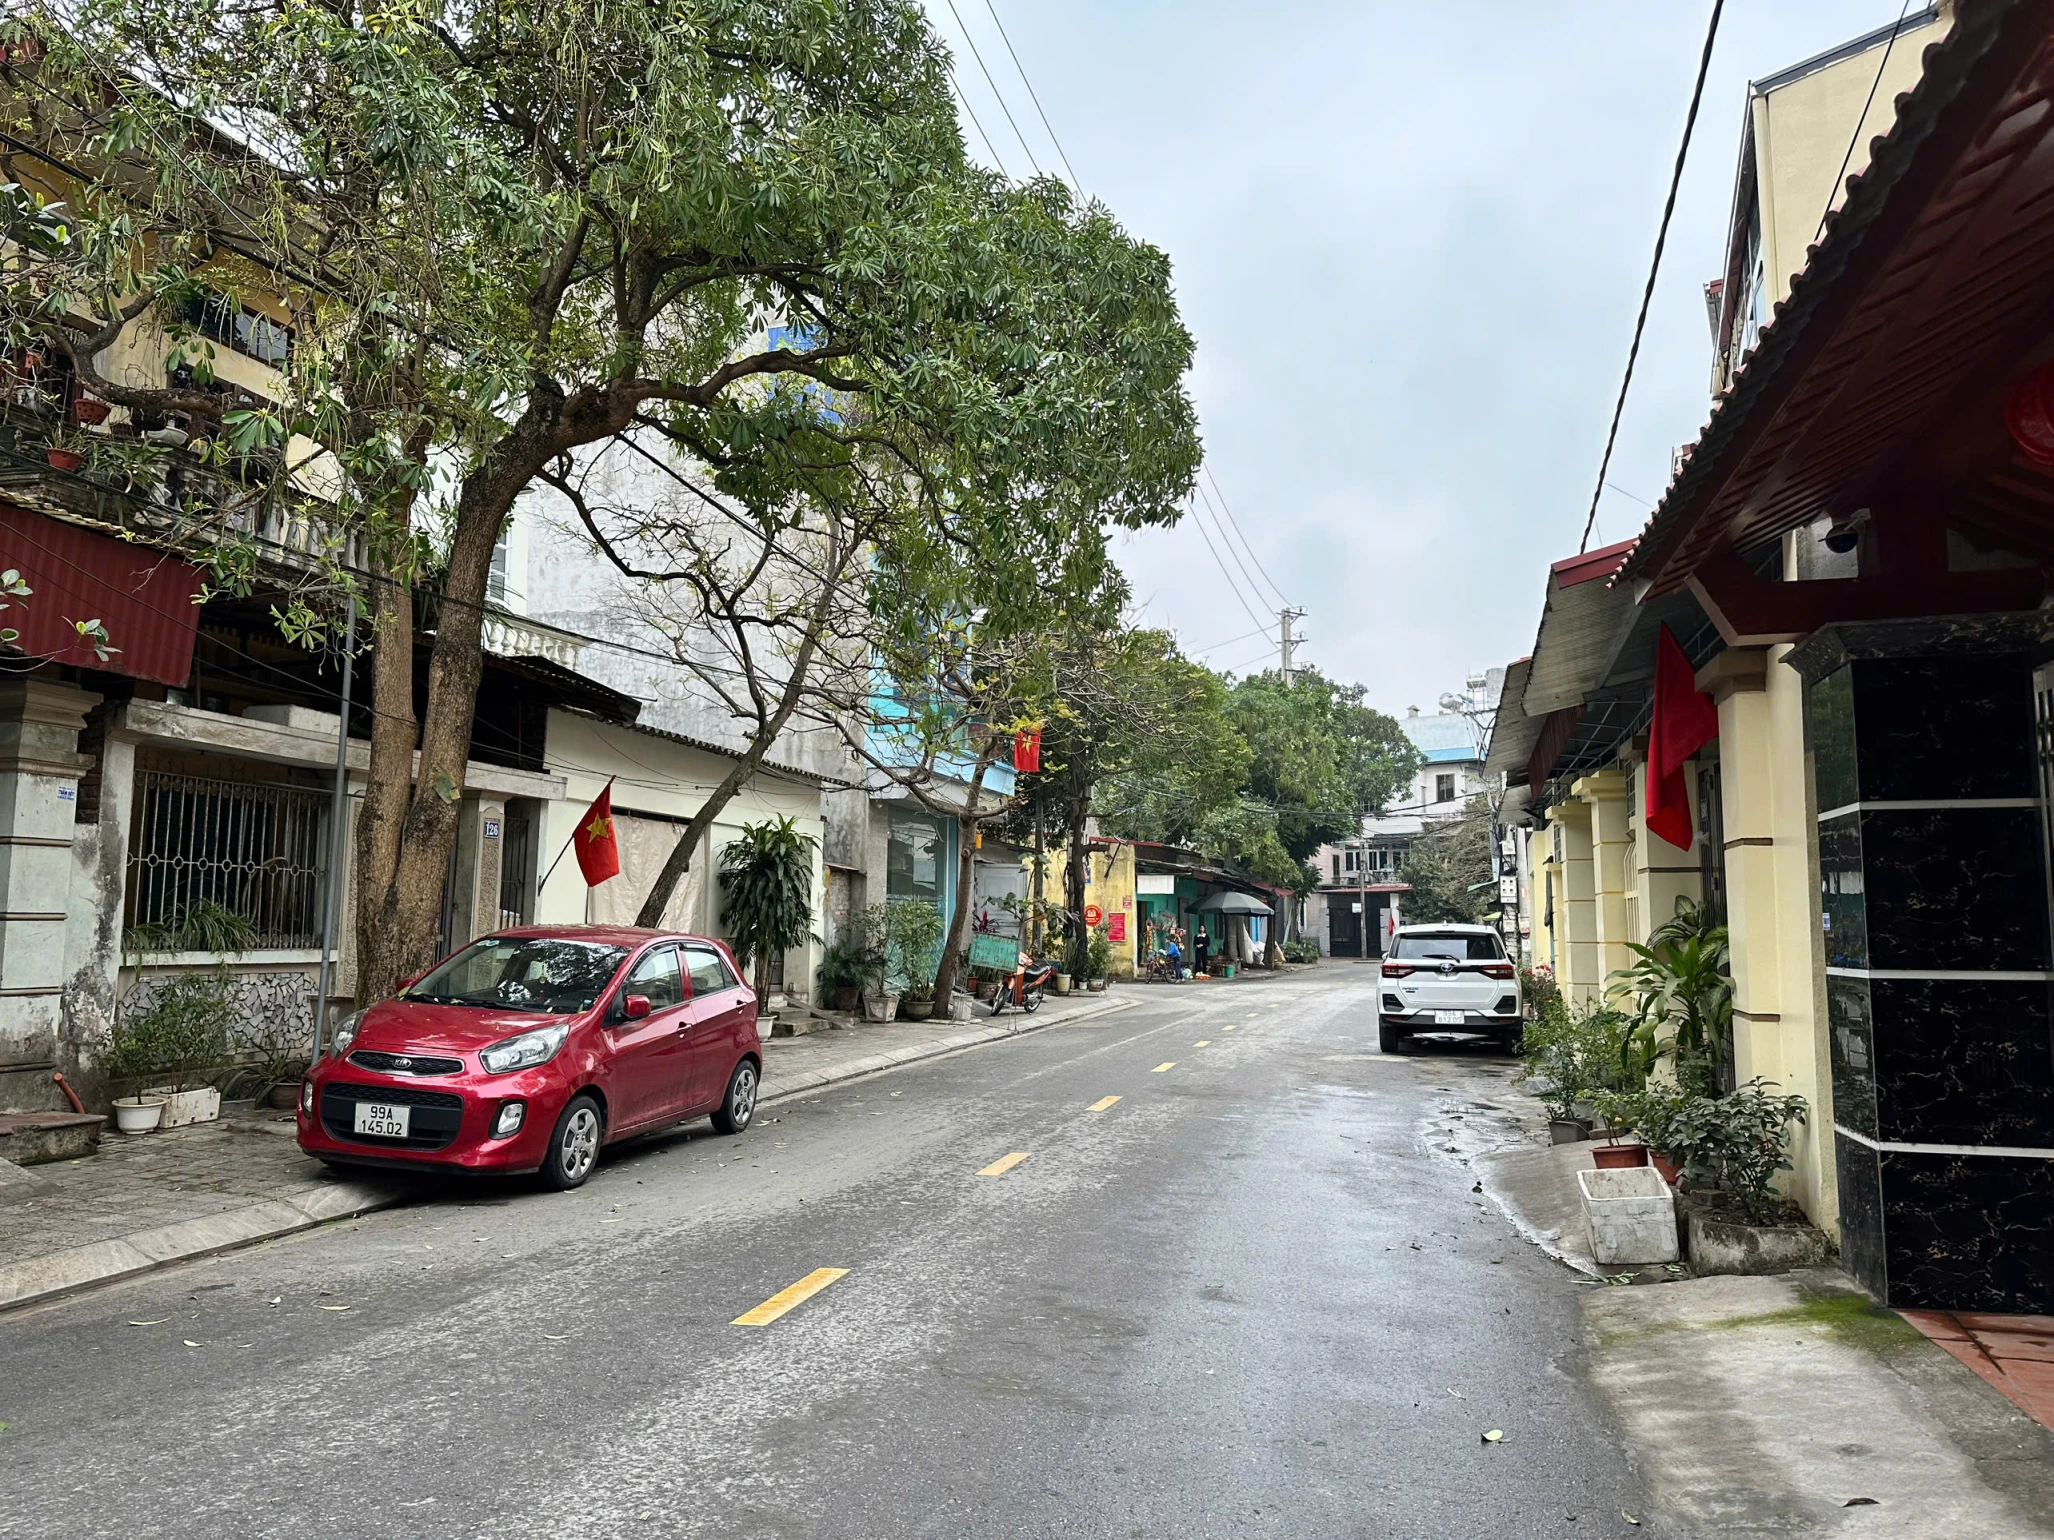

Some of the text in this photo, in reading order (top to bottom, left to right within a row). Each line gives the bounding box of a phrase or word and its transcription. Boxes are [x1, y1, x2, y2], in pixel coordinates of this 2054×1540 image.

[486, 822, 498, 836] 126
[370, 1106, 393, 1120] 99A
[361, 1119, 402, 1136] 145.02
